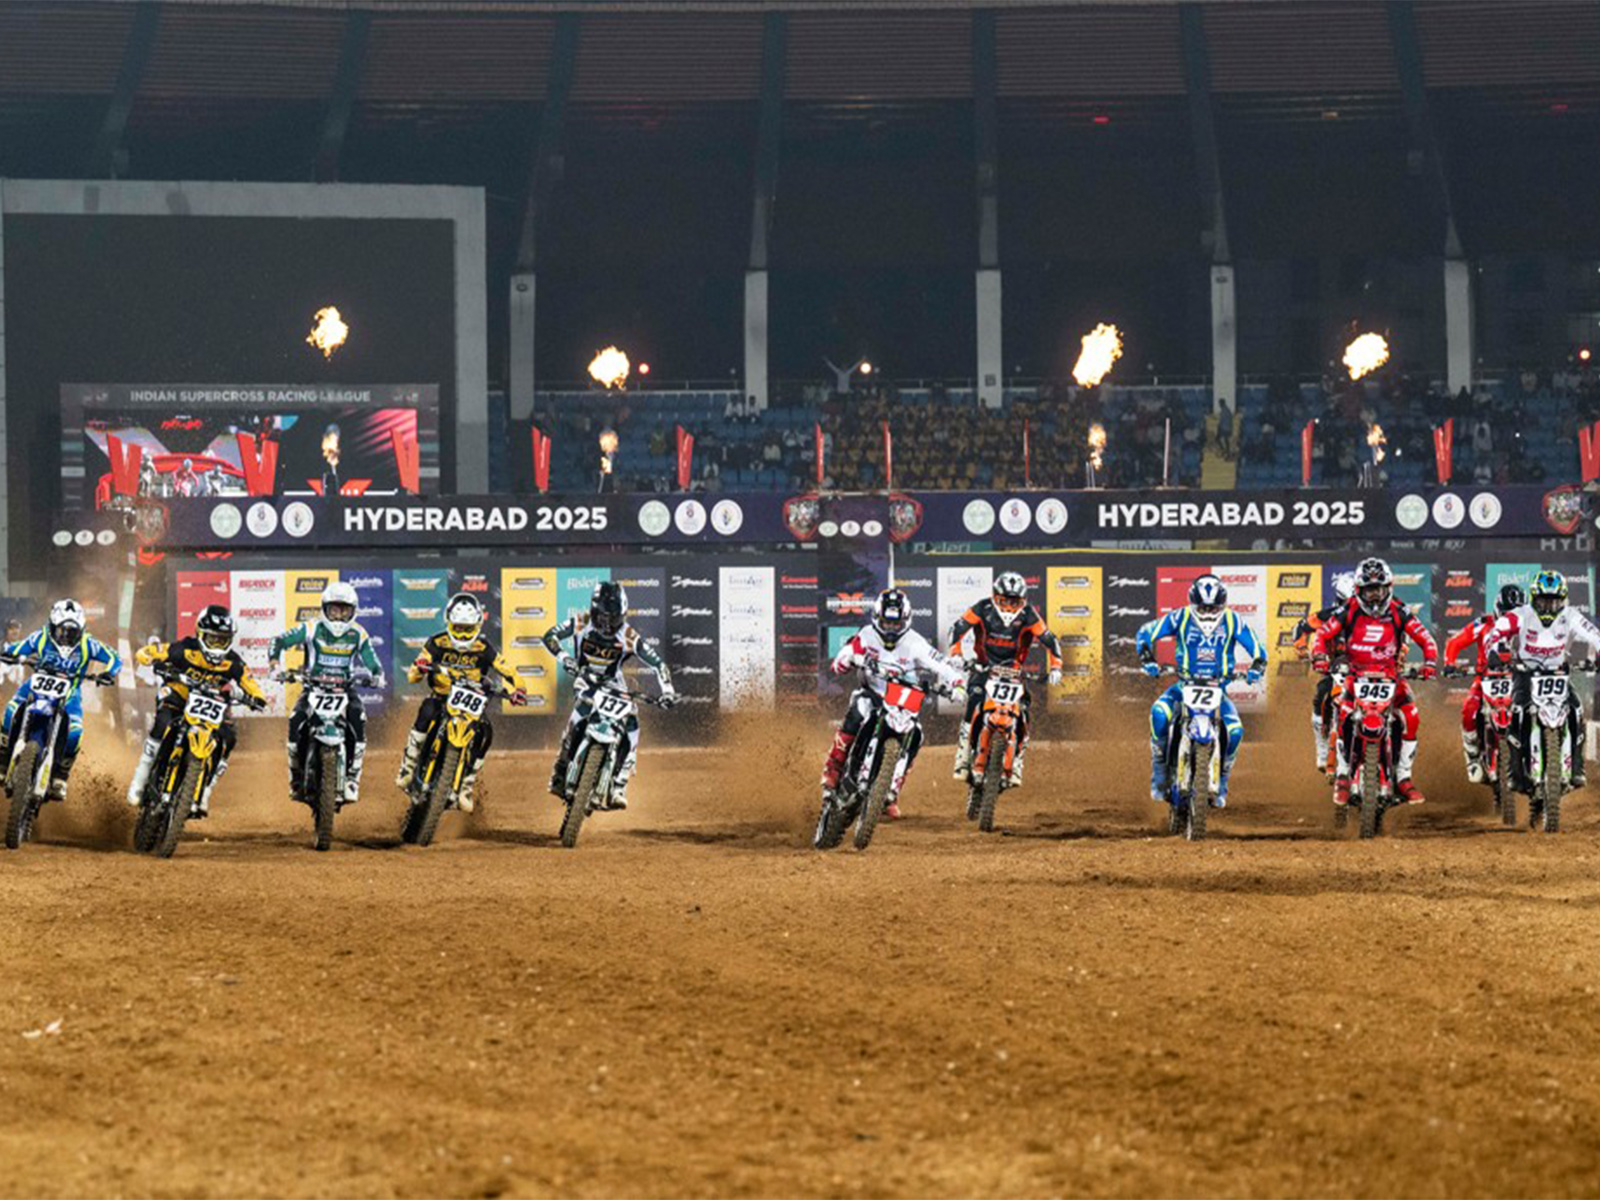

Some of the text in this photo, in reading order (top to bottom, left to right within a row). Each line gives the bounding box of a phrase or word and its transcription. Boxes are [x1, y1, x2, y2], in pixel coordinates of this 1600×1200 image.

[130, 390, 371, 402] INDIAN SUPERCROSS RACING LEAGUE
[344, 506, 608, 532] HYDERABAD 2025
[1098, 500, 1365, 528] HYDERABAD 2025
[33, 676, 67, 694] 384
[992, 684, 1018, 701] 131
[1359, 685, 1390, 699] 945
[1491, 681, 1510, 695] 58
[1538, 679, 1565, 696] 199
[315, 695, 345, 711] 727
[451, 690, 483, 712] 848
[898, 688, 911, 705] 1
[1191, 688, 1214, 705] 72
[190, 698, 222, 721] 225
[599, 696, 628, 715] 137
